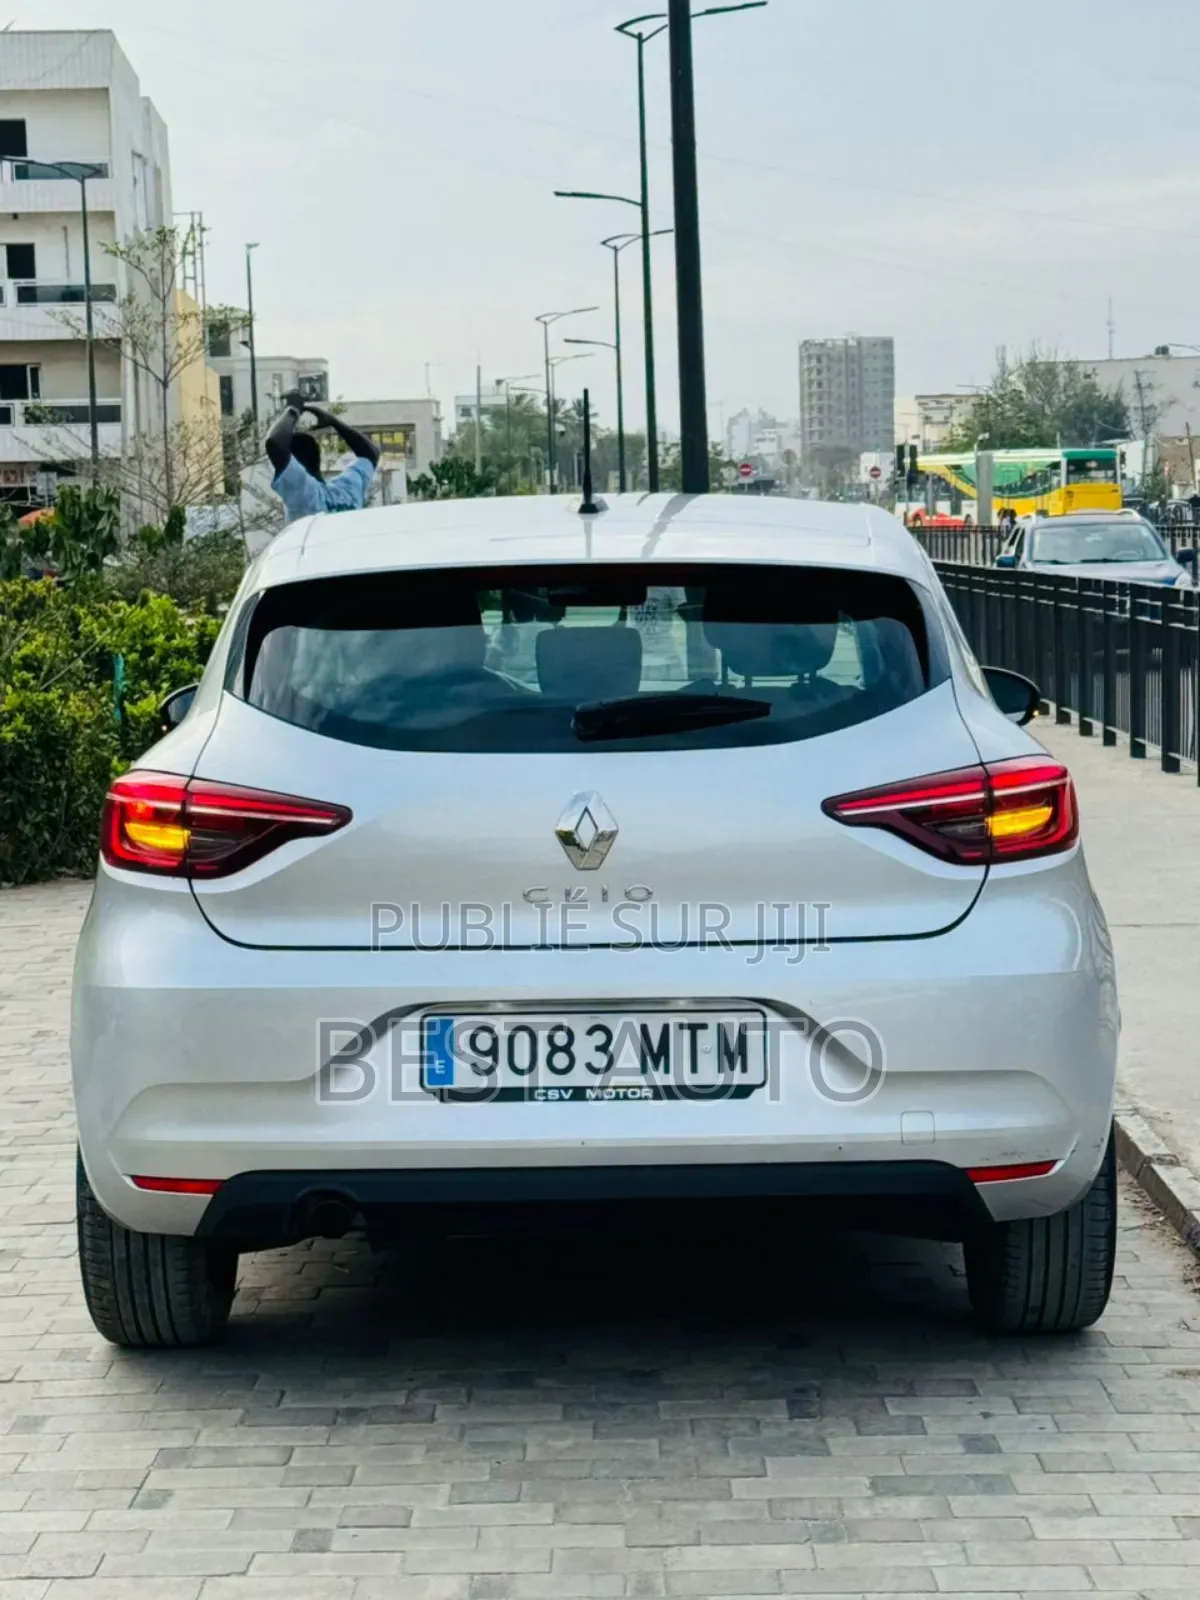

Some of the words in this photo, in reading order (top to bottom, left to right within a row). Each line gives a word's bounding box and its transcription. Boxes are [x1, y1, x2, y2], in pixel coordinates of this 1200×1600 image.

[522, 884, 654, 903] CLIO
[468, 1024, 615, 1077] 9083
[640, 1022, 749, 1075] MTM
[435, 1059, 446, 1075] E
[534, 1088, 574, 1101] CSV
[585, 1087, 655, 1101] MOTOR
